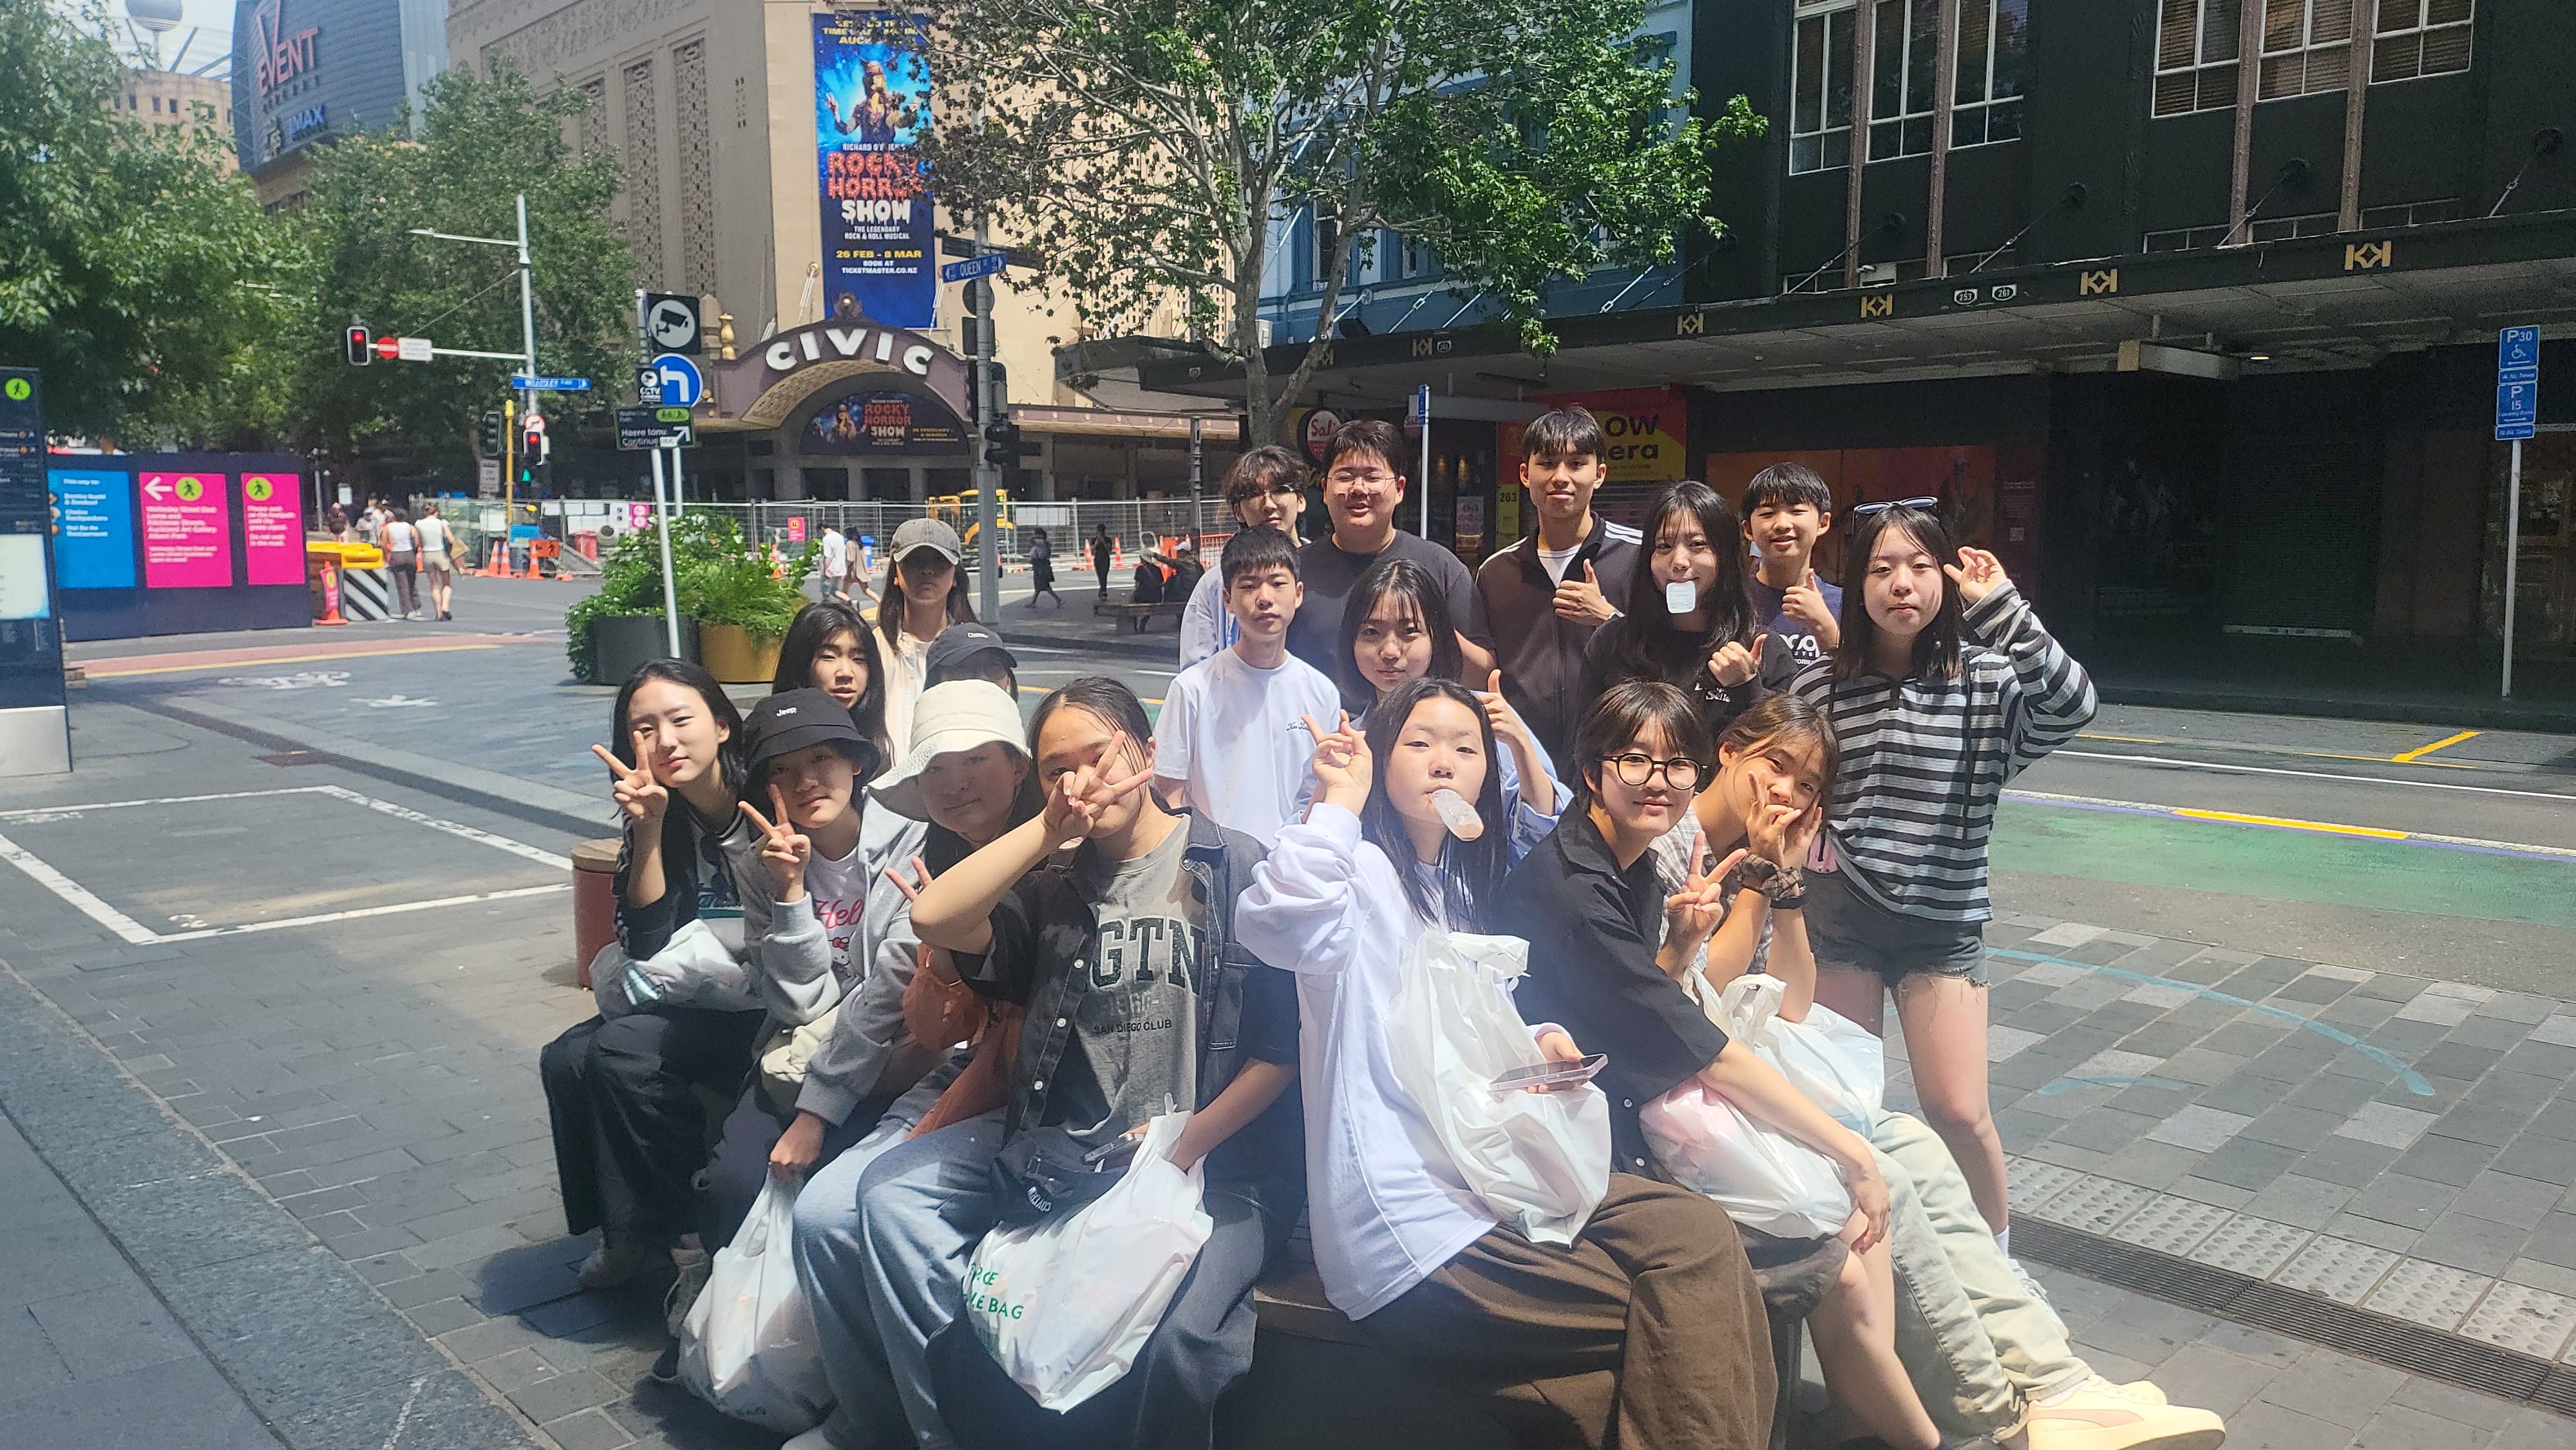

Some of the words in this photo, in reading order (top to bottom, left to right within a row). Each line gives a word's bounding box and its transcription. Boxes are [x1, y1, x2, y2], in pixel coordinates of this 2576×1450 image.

[257, 0, 318, 97] EVENT
[842, 200, 911, 225] SHOW
[960, 261, 981, 277] QUEEN
[1958, 293, 1972, 301] 253
[766, 329, 934, 375] CIVIC
[2512, 386, 2523, 398] P
[865, 404, 909, 415] ROCKY
[2512, 400, 2522, 410] 15
[871, 426, 905, 437] SHOW
[622, 438, 658, 446] Continue
[776, 707, 797, 717] Jeep
[1117, 1021, 1142, 1033] DIEGO
[1143, 1019, 1172, 1031] CLUB
[989, 1297, 1024, 1319] BAG
